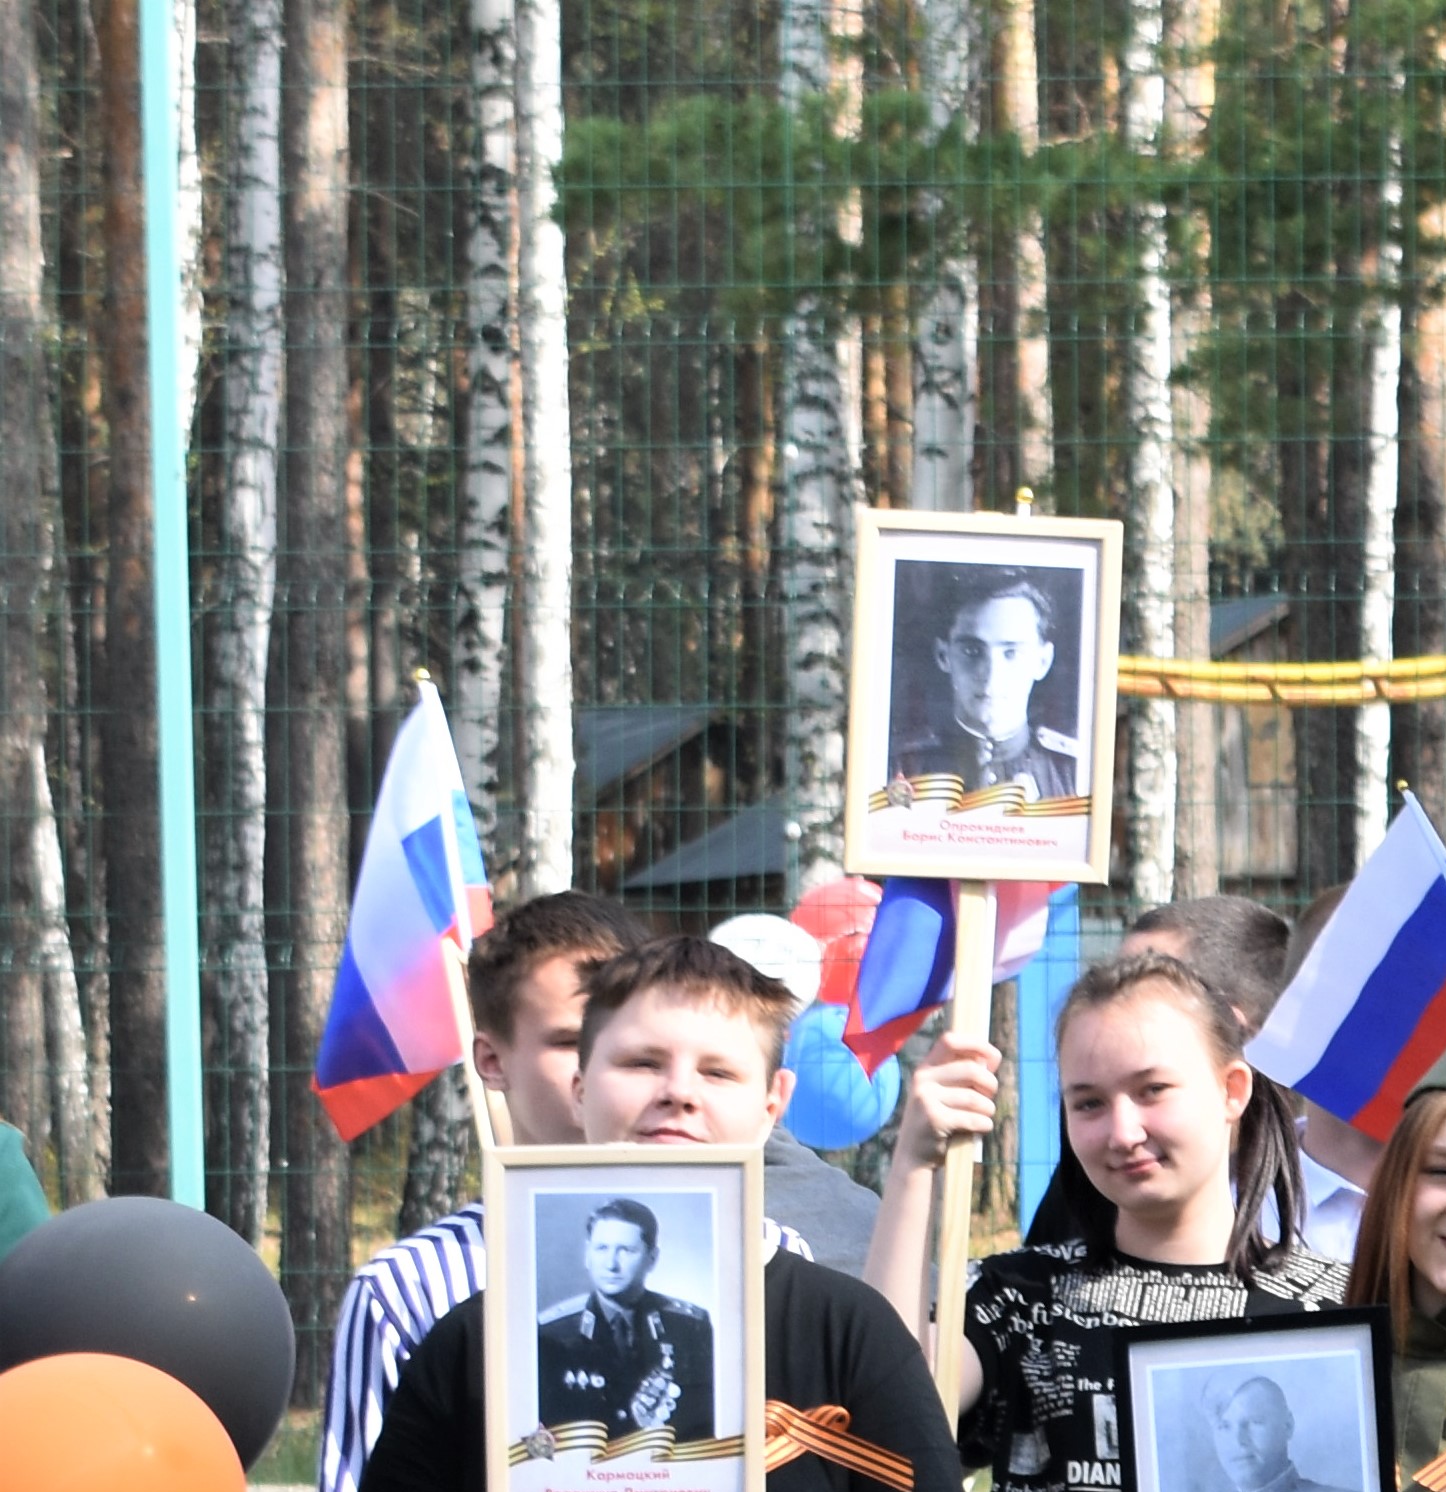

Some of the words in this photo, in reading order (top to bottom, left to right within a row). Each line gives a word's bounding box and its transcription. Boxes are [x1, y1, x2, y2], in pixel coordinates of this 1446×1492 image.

[902, 830, 943, 844] Борис
[948, 832, 1058, 848] Константинович
[586, 1467, 670, 1483] Кармацкий
